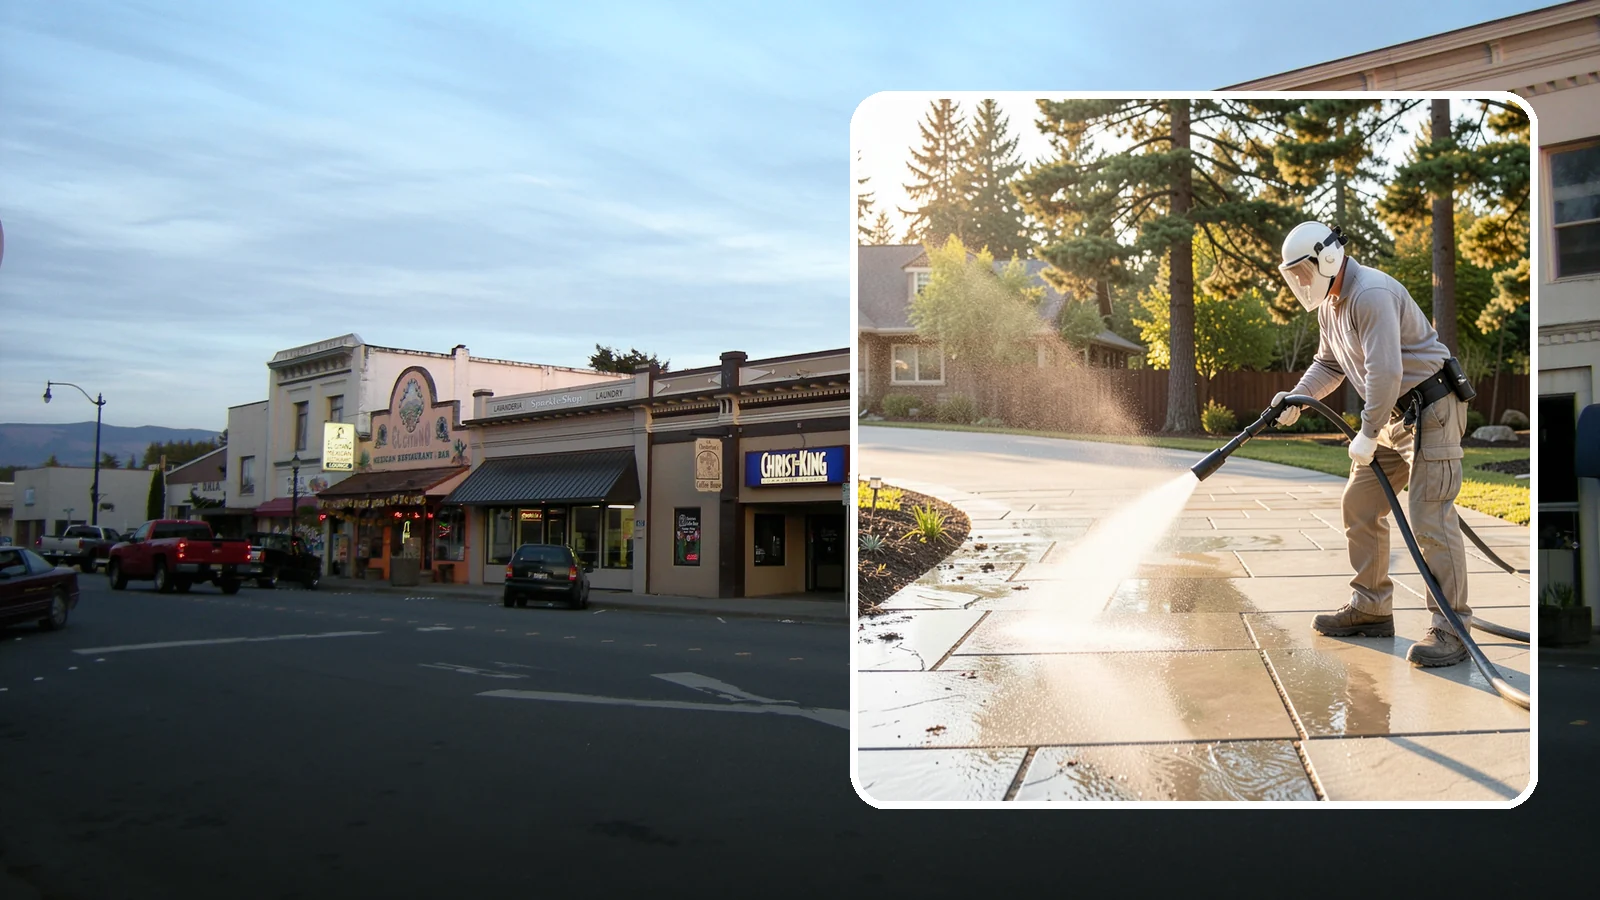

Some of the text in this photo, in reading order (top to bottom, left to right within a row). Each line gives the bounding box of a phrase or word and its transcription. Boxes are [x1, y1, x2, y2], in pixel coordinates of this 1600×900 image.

[596, 389, 624, 400] LAUNDRY
[494, 402, 523, 413] LAVANDERIA
[531, 394, 582, 409] Sparkle Shop
[373, 456, 396, 464] MEXICAN
[397, 452, 433, 462] RESTAURANT
[438, 450, 450, 459] BAR
